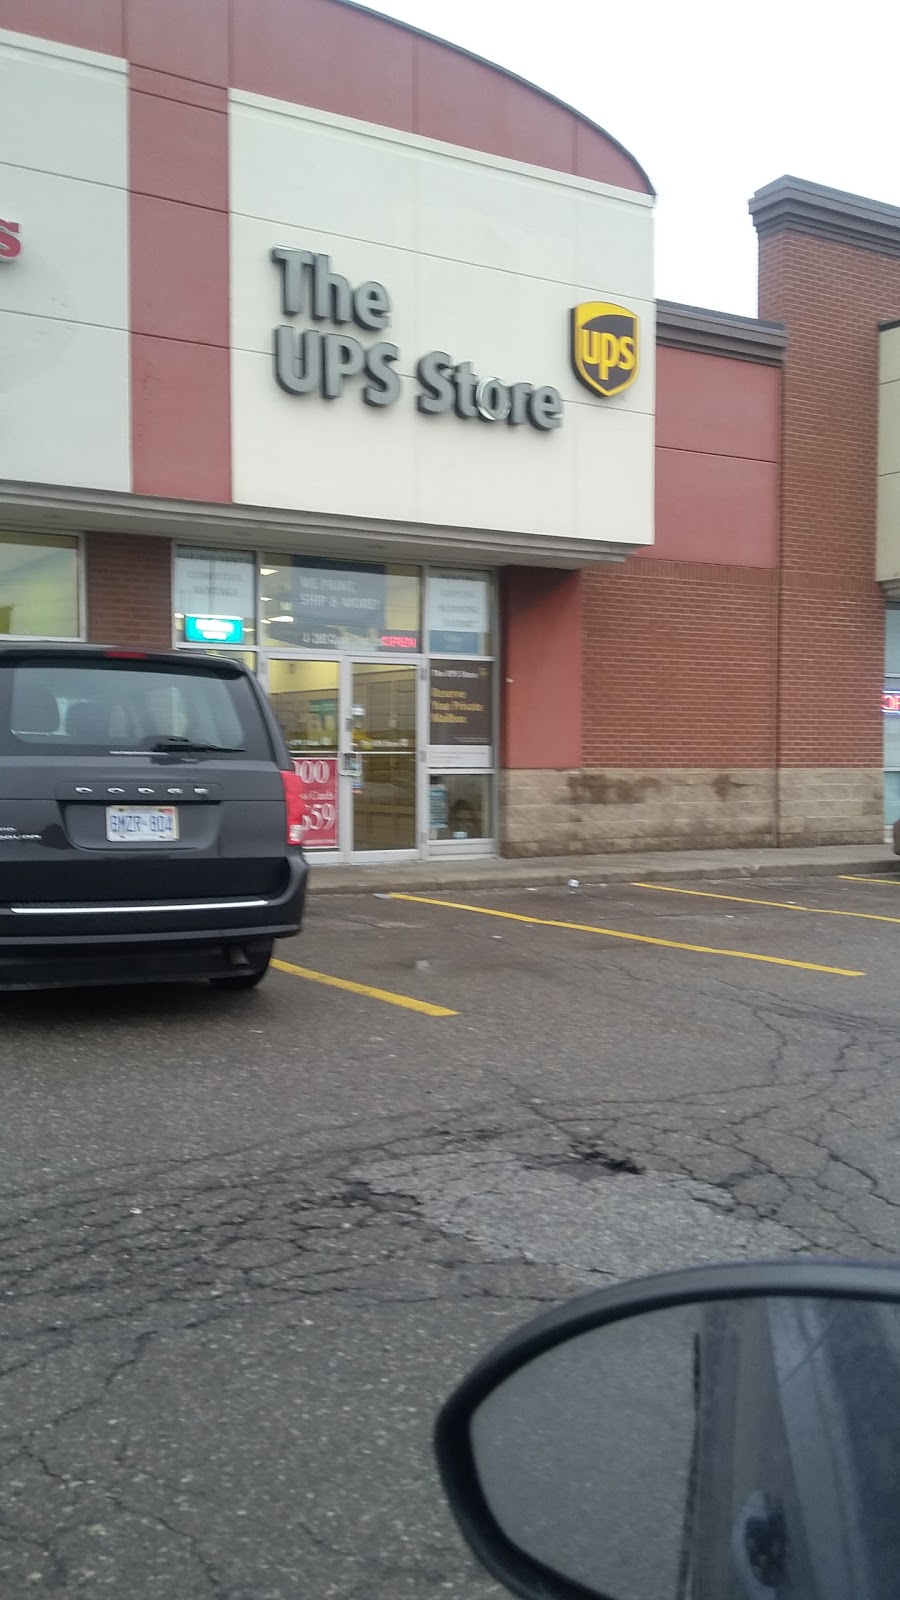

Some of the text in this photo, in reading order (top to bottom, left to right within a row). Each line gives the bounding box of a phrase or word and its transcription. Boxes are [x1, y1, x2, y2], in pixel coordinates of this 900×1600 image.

[272, 245, 391, 331] The
[275, 324, 563, 431] UPS Store
[582, 329, 636, 381] ups
